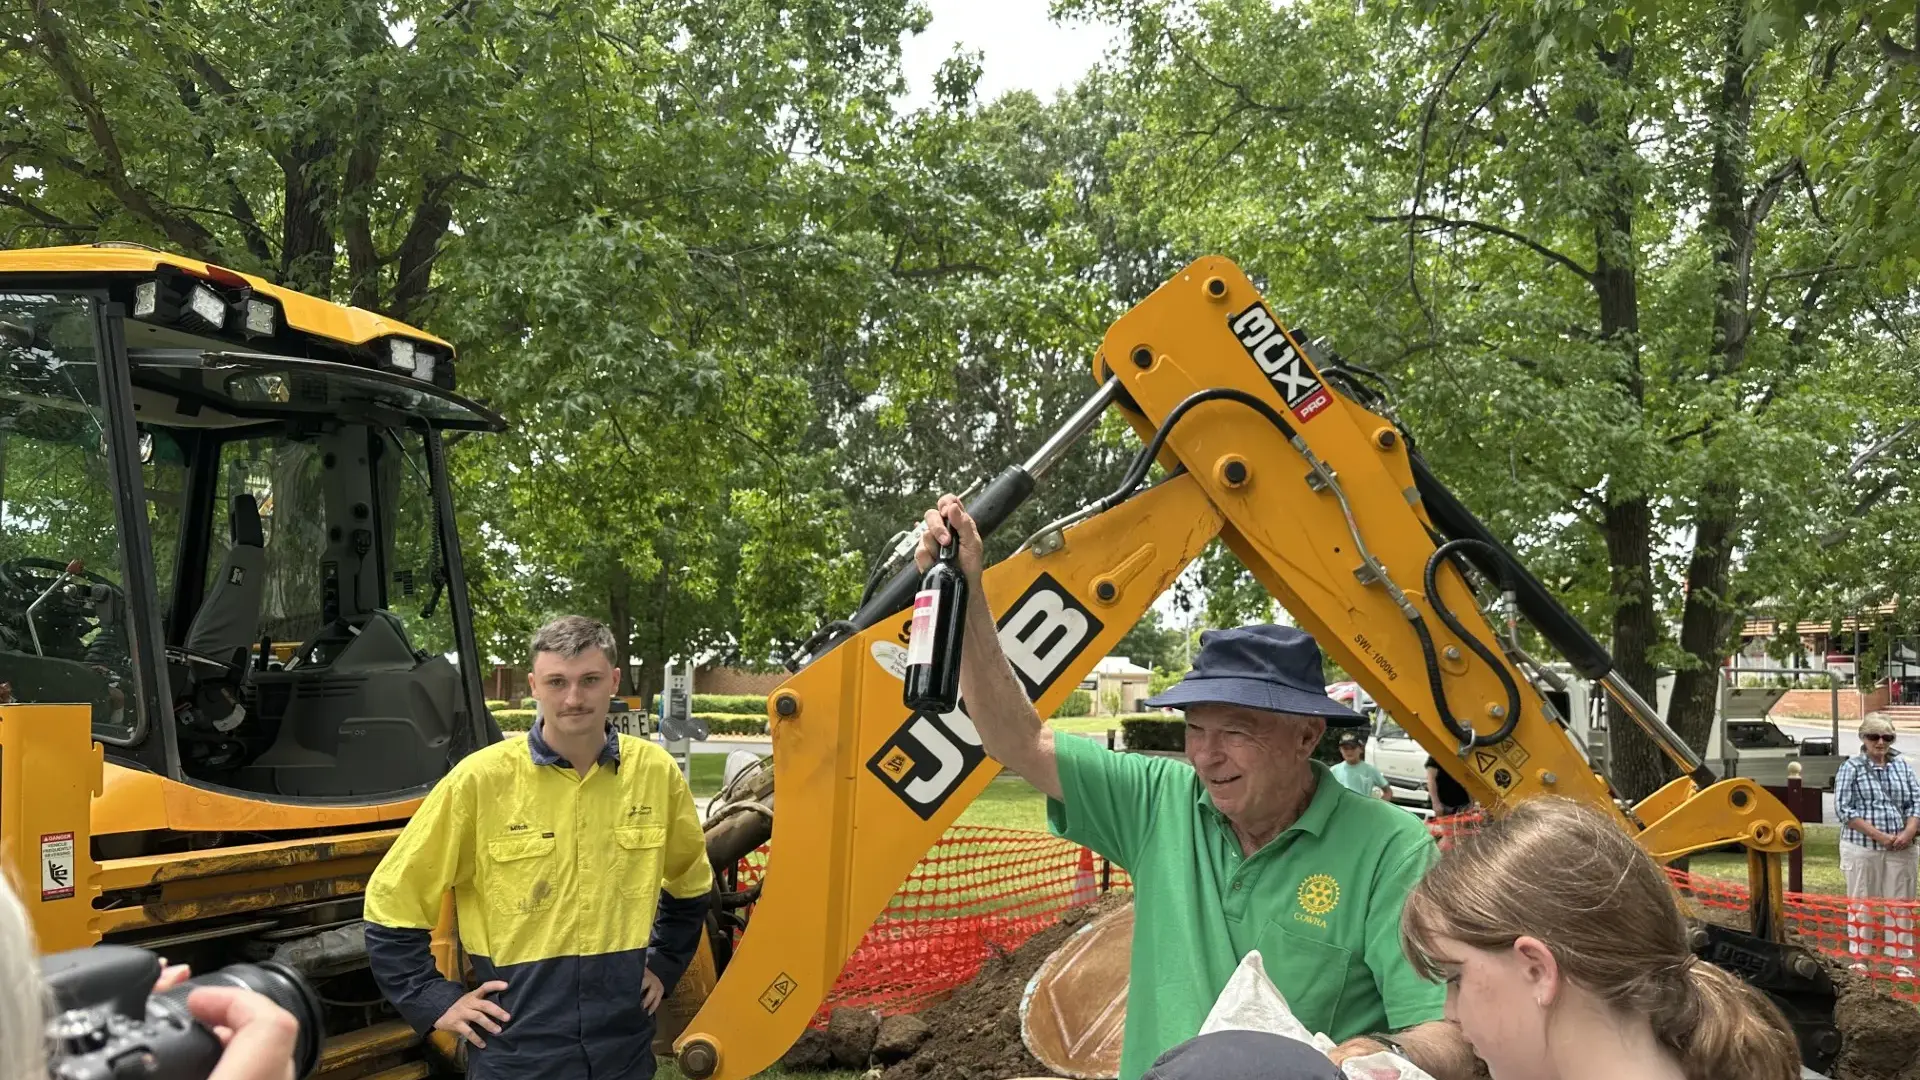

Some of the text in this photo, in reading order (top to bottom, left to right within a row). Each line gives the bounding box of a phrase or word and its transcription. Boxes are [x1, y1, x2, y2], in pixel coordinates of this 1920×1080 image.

[1233, 306, 1317, 404] 3CX
[1299, 395, 1327, 418] PRO
[1293, 912, 1327, 928] COWRA
